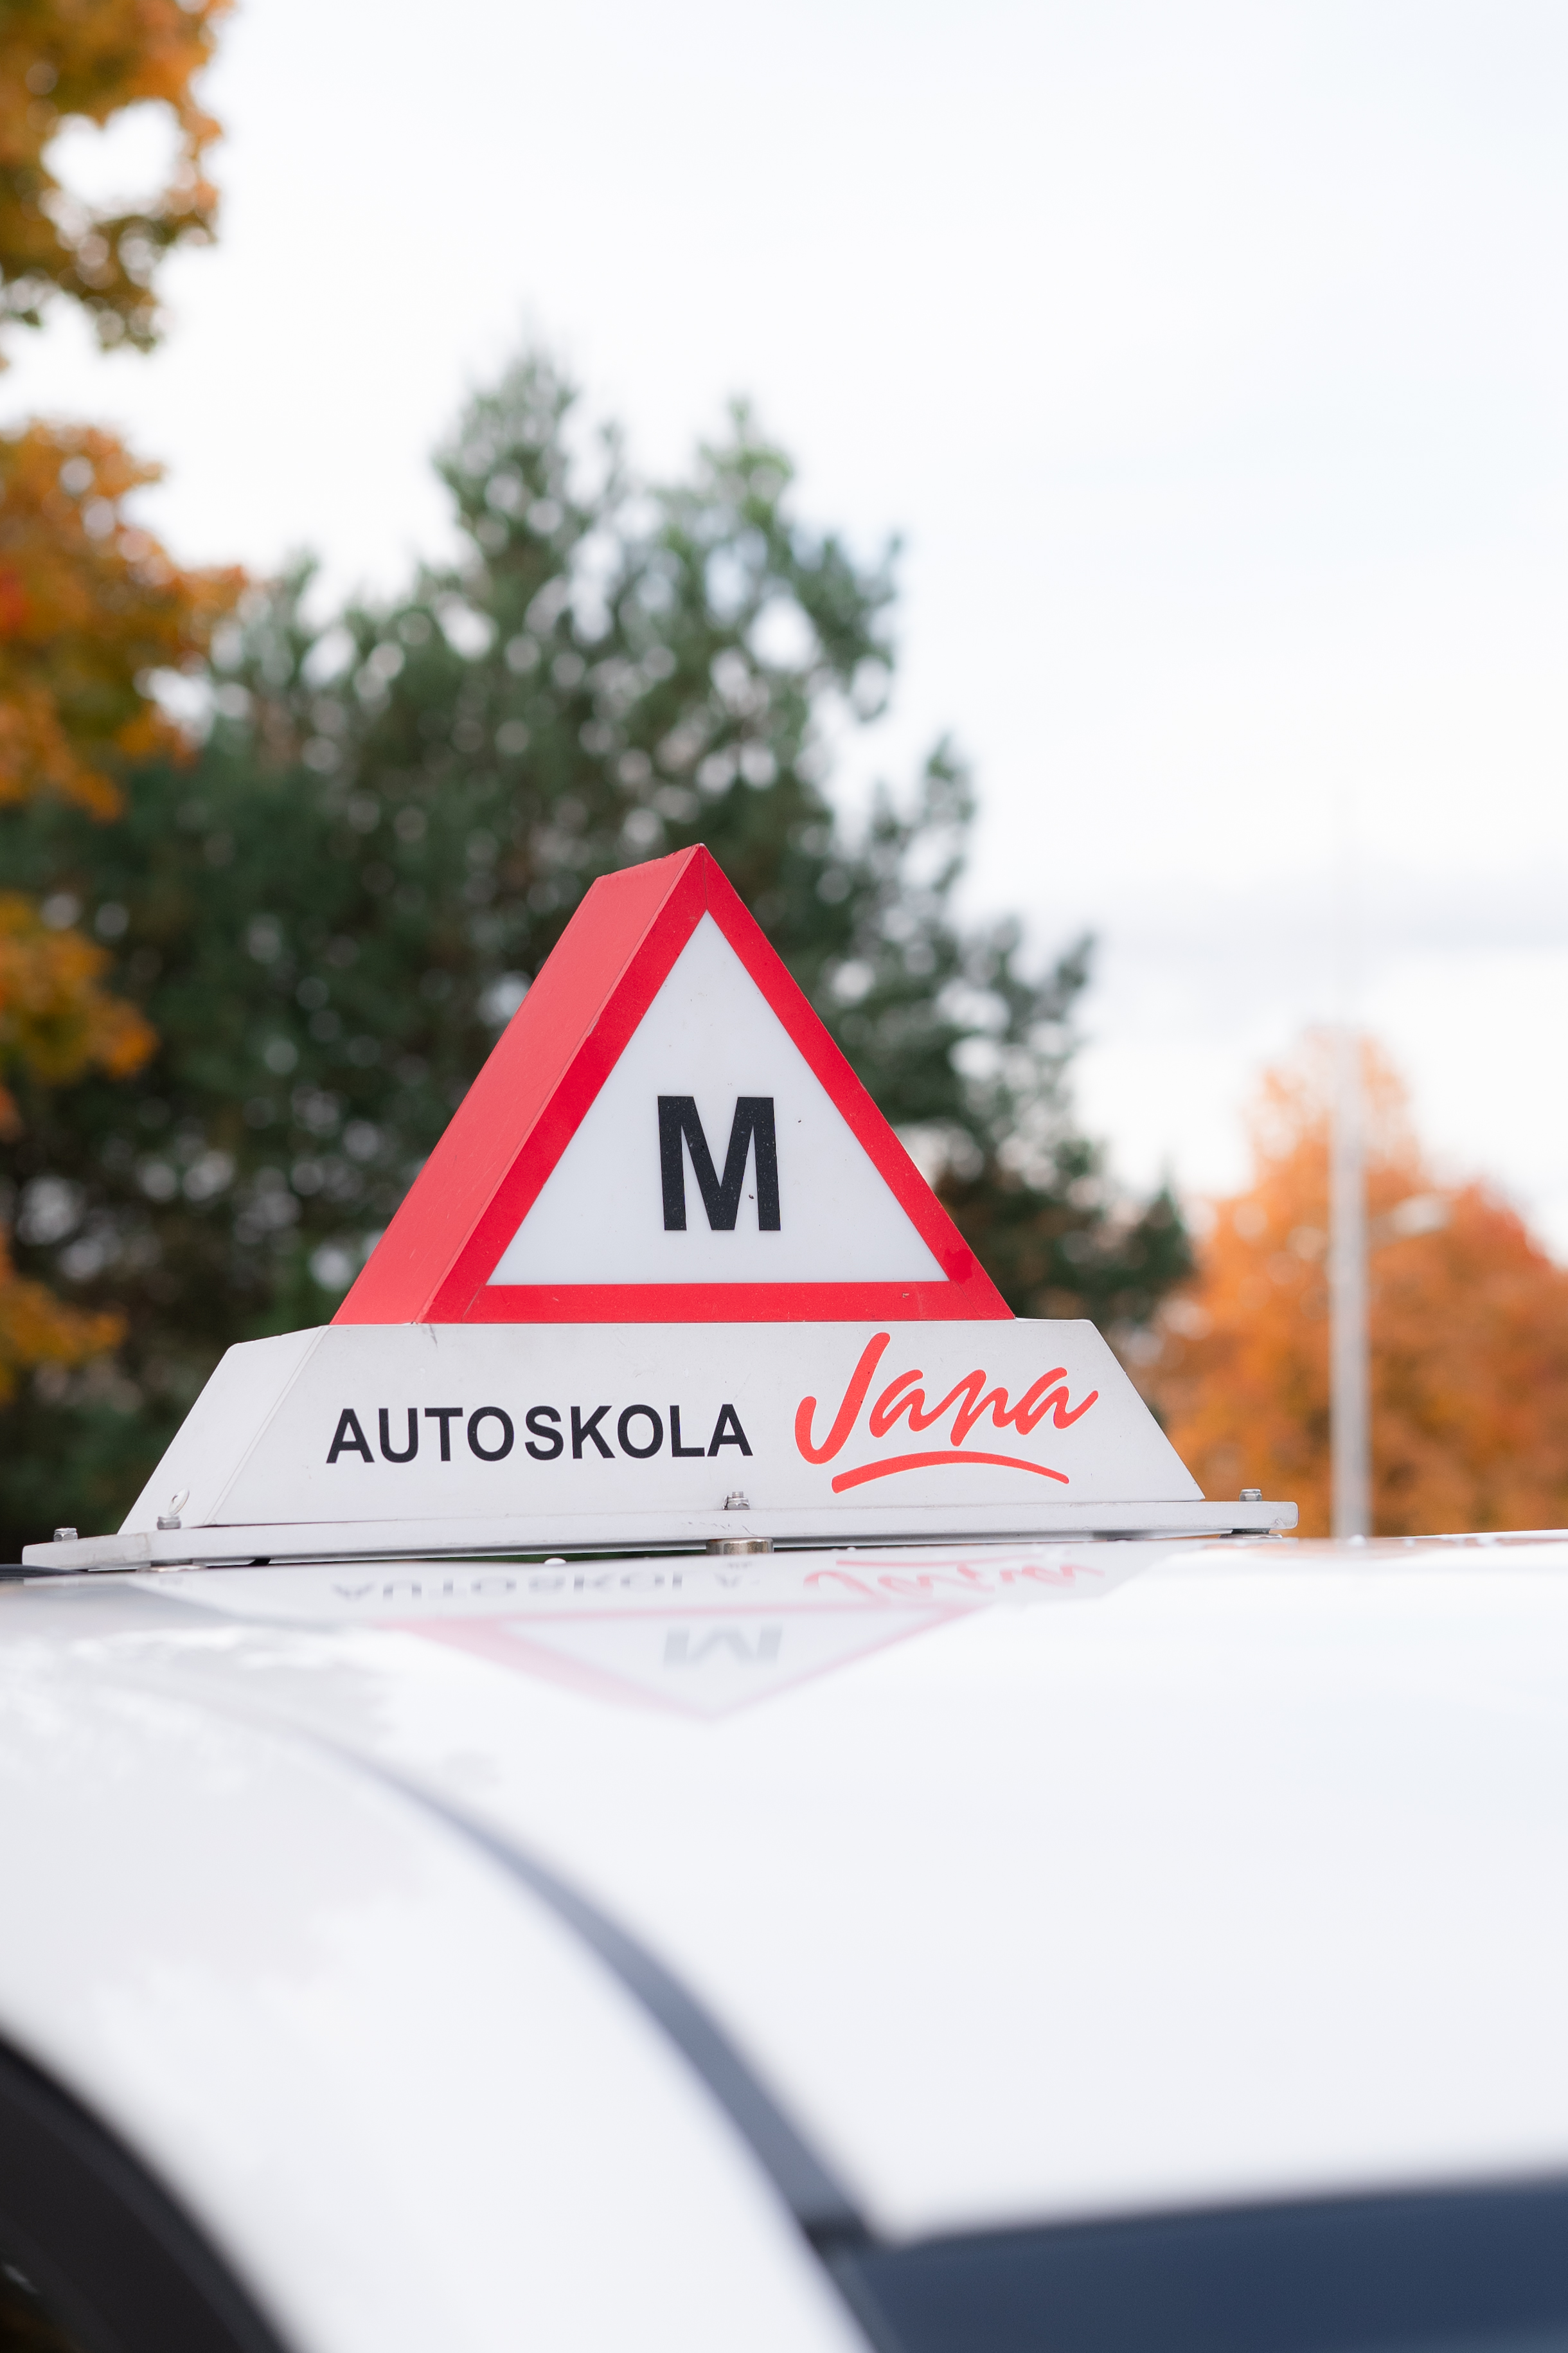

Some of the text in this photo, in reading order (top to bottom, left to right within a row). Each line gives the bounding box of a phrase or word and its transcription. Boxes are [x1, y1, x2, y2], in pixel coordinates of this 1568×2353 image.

[657, 1095, 781, 1232] M
[326, 1331, 1100, 1465] AUTOSKOLA Jana
